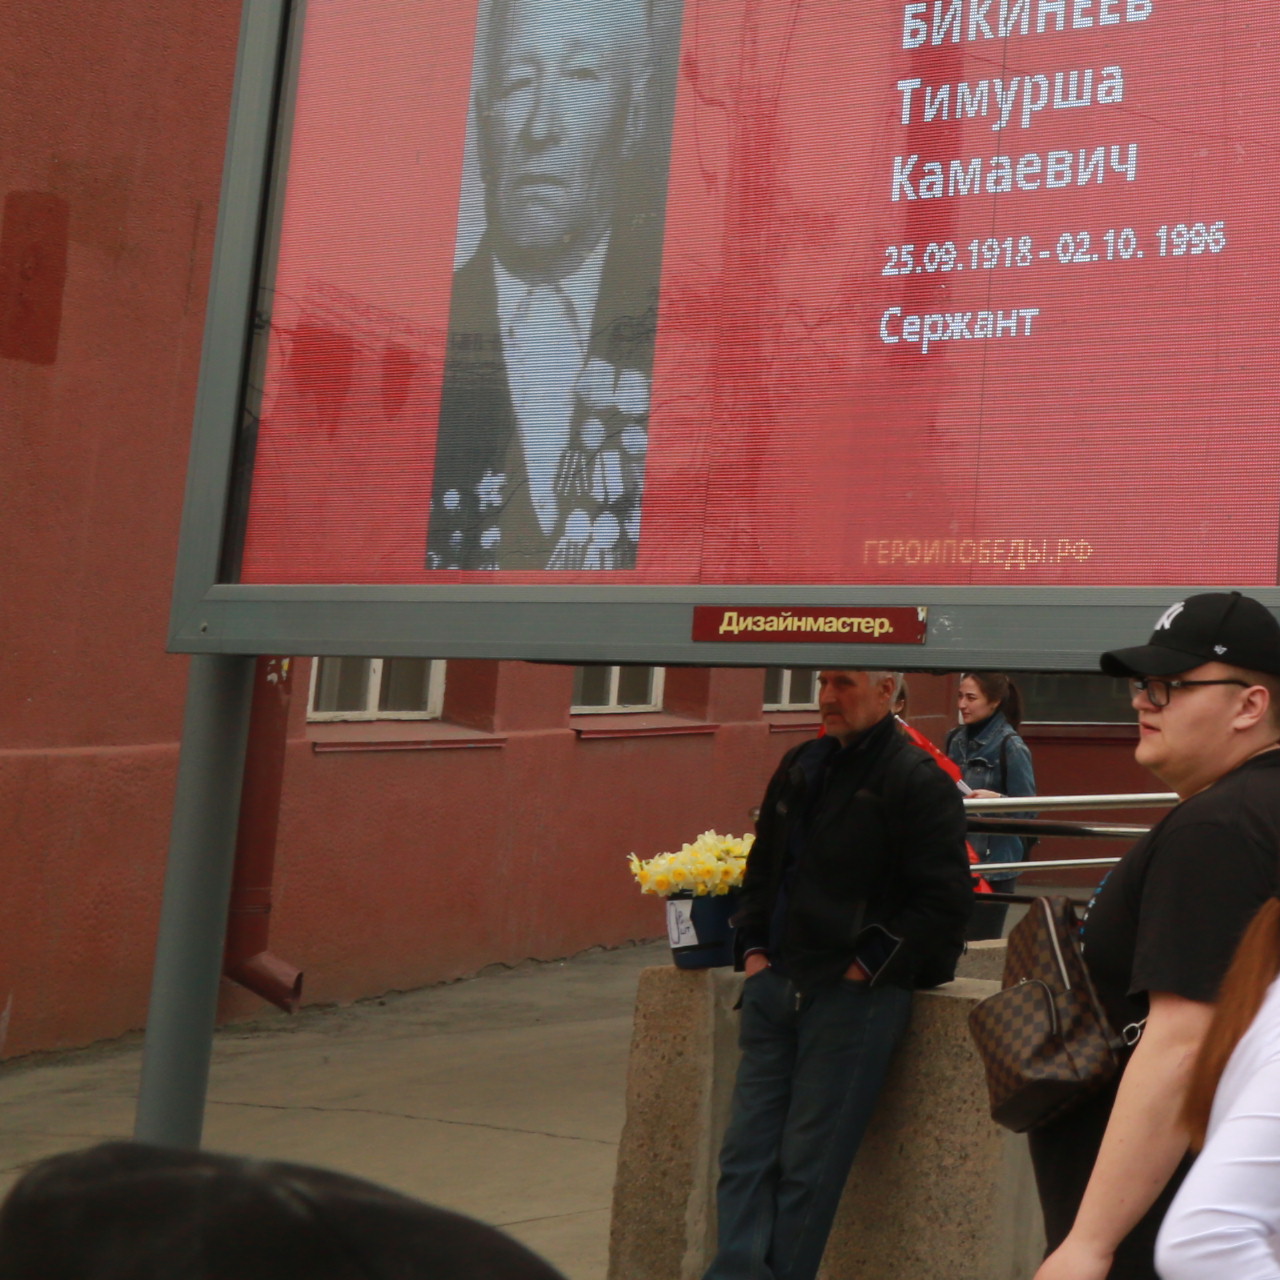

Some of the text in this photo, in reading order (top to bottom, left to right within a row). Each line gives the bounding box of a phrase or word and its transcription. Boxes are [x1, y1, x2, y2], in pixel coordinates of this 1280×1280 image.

[896, 65, 1125, 132] Тимурша
[890, 143, 1139, 202] Камаевич
[878, 305, 1041, 355] Сержант
[863, 538, 1094, 570] ГЕРОИПОБЕДЫ.РФ
[718, 611, 894, 638] Дизайнмастер.
